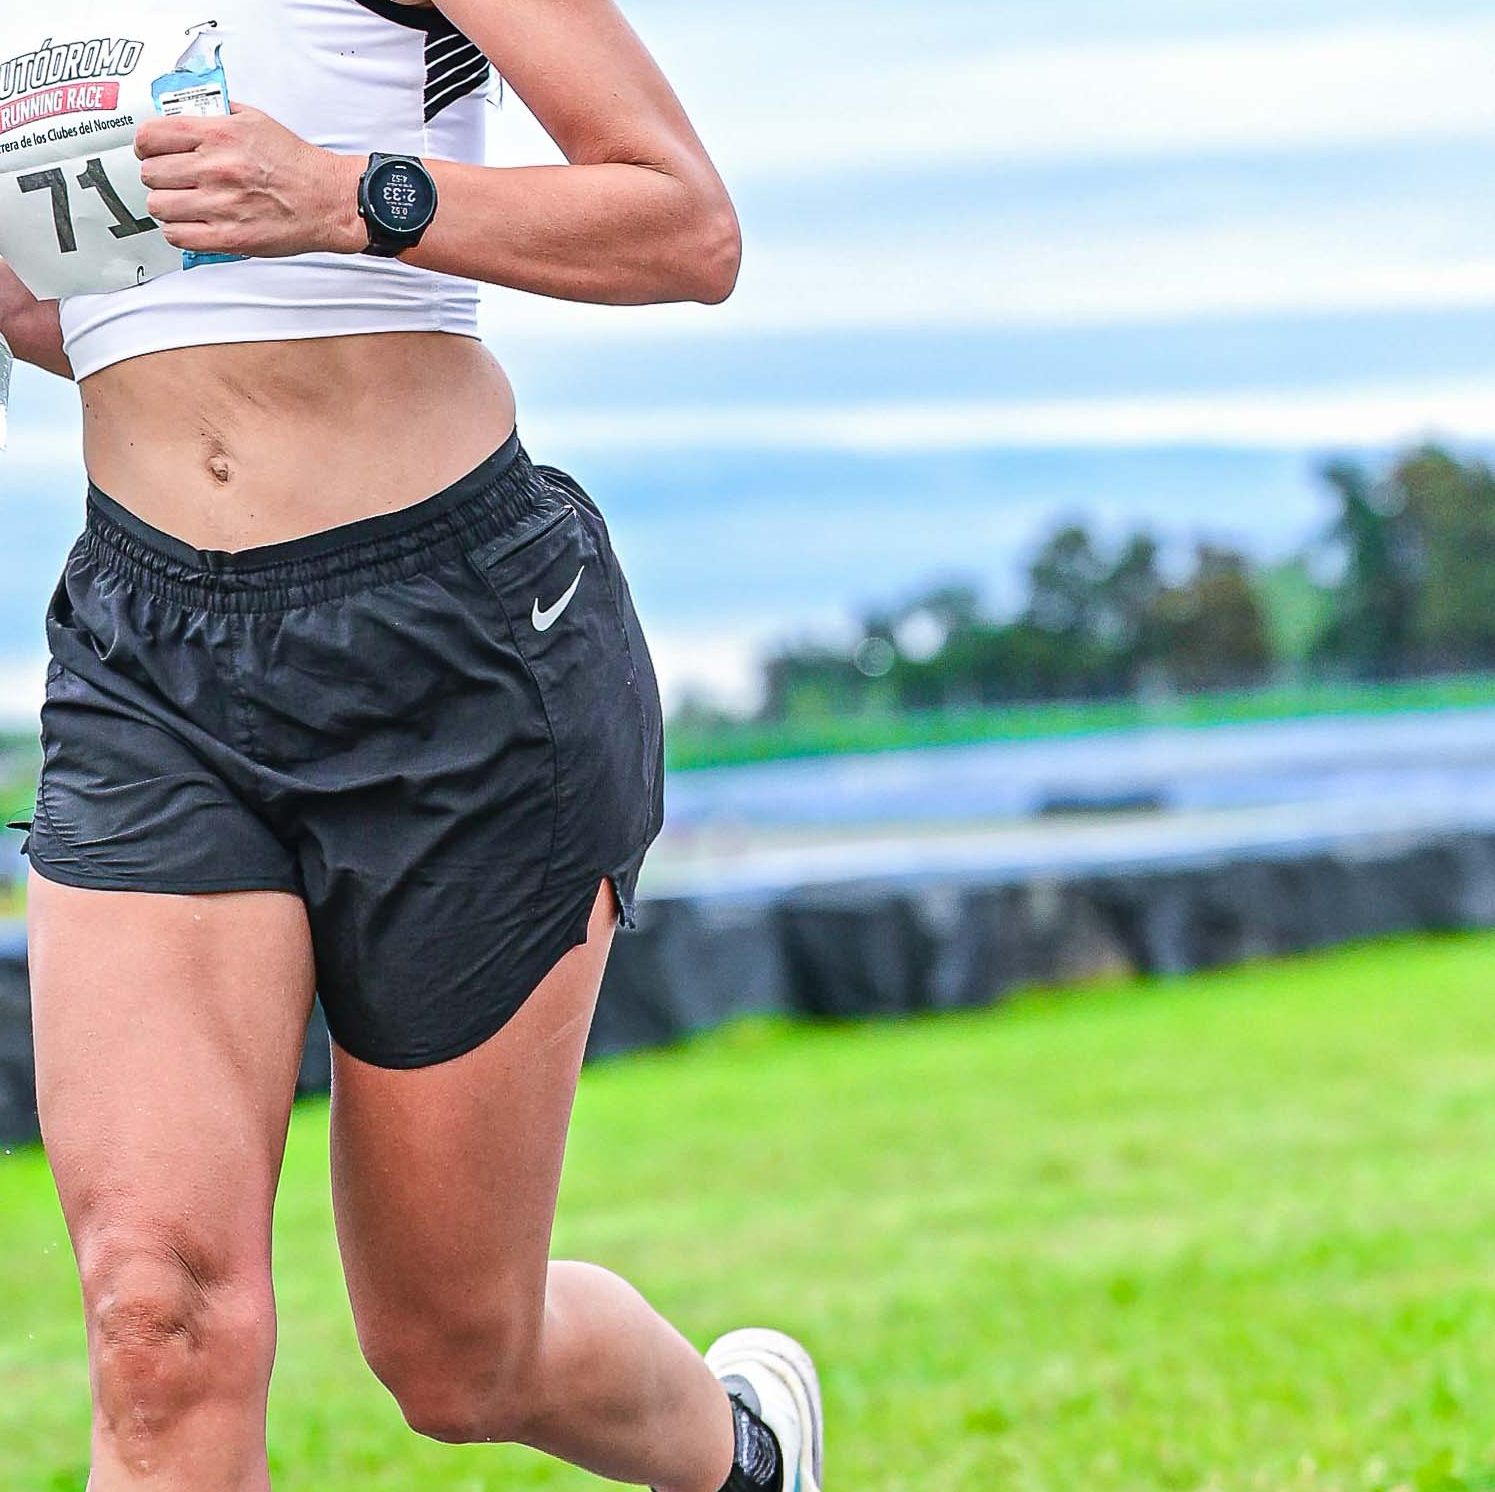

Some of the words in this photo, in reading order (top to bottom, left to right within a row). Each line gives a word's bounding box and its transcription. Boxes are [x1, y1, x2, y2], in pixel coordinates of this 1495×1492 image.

[0, 88, 63, 131] RUNNING
[66, 85, 105, 111] RACE
[20, 135, 32, 149] de
[33, 132, 47, 145] los
[47, 123, 78, 142] Clubes
[79, 120, 94, 135] del
[94, 114, 134, 131] Noroeste
[383, 186, 416, 203] 2:33
